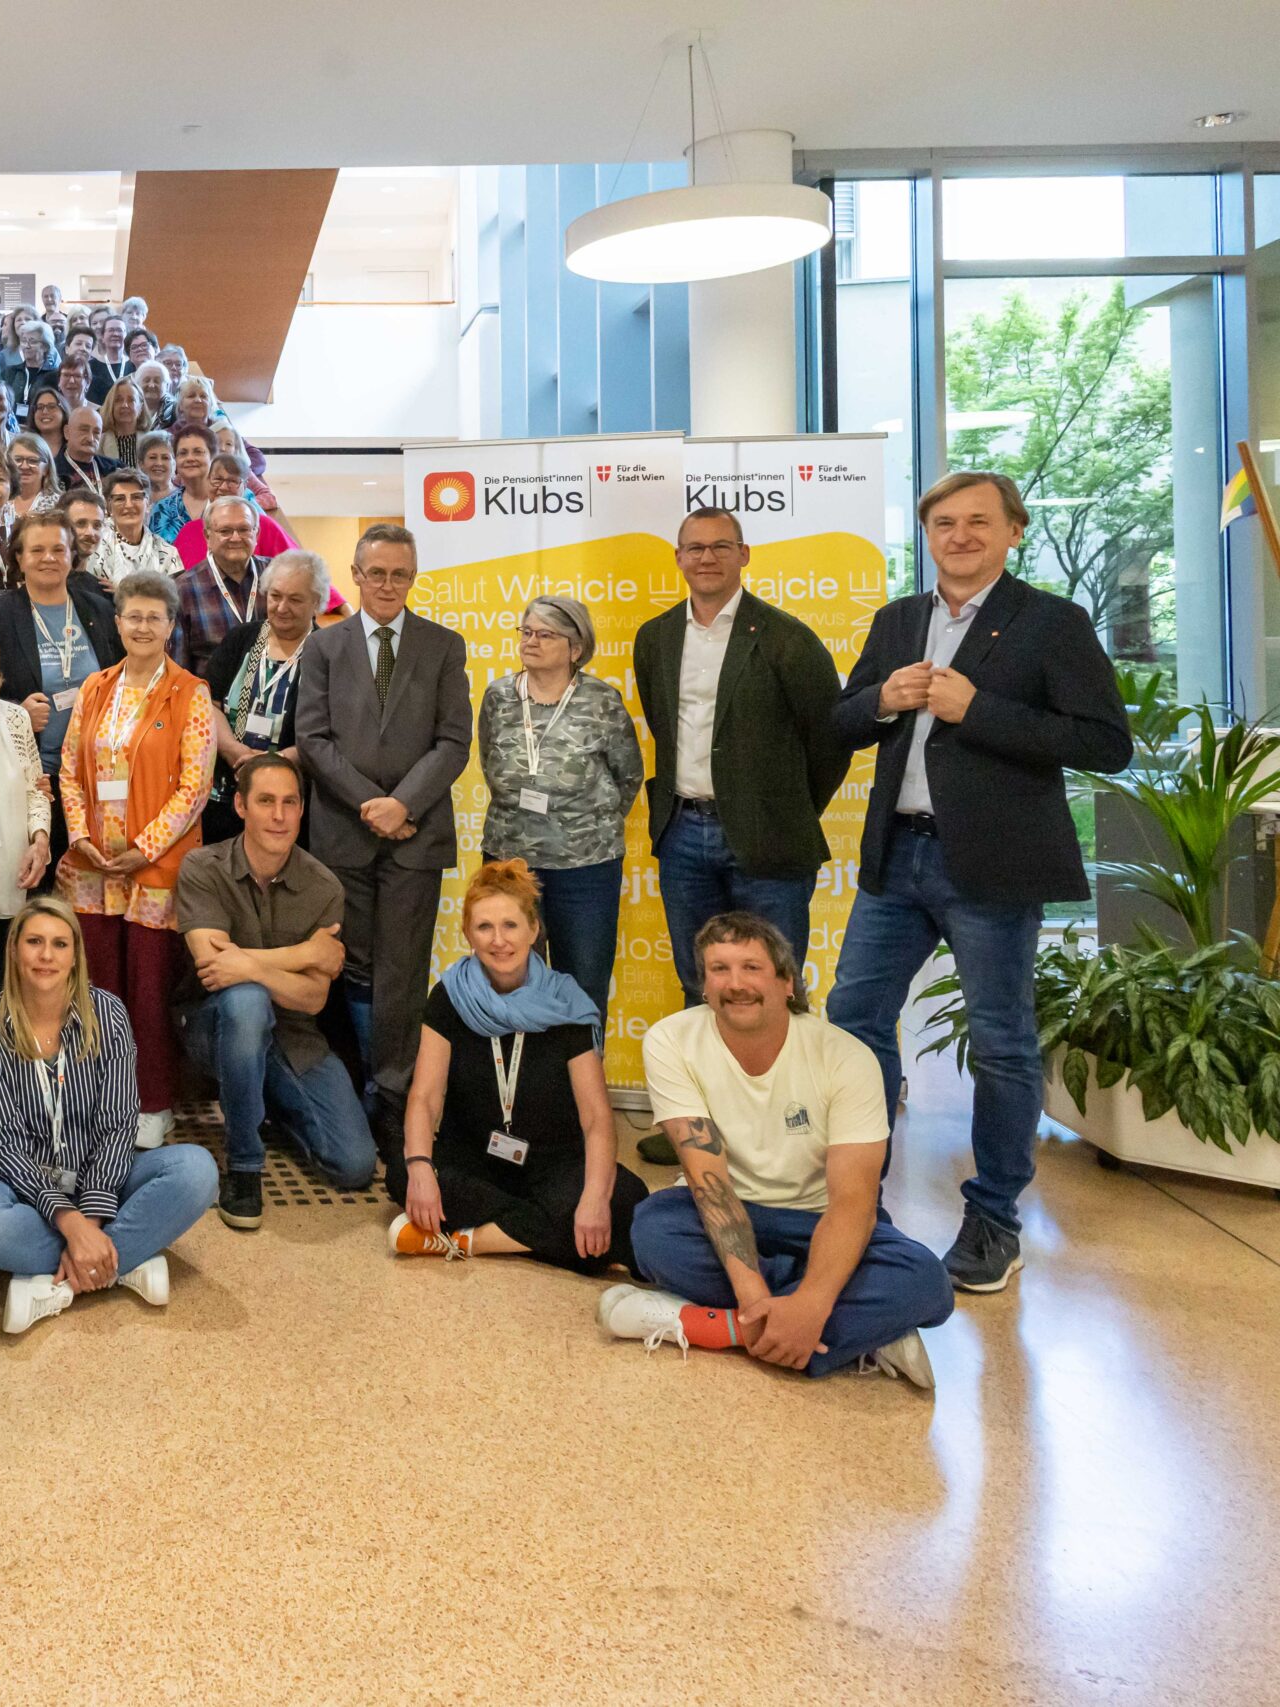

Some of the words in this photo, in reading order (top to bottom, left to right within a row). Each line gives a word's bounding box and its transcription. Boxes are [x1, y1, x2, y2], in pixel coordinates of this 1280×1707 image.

[617, 464, 631, 473] Für
[633, 464, 647, 472] die
[818, 465, 832, 473] Für
[484, 476, 500, 485] Die
[617, 474, 640, 482] Stadt
[641, 473, 665, 482] Wien
[685, 474, 701, 482] Die
[818, 474, 841, 482] Stadt
[842, 474, 866, 482] Wien
[484, 485, 584, 515] Klubs
[685, 484, 786, 513] Klubs
[413, 574, 488, 604] Salut
[497, 572, 638, 603] Witajcie
